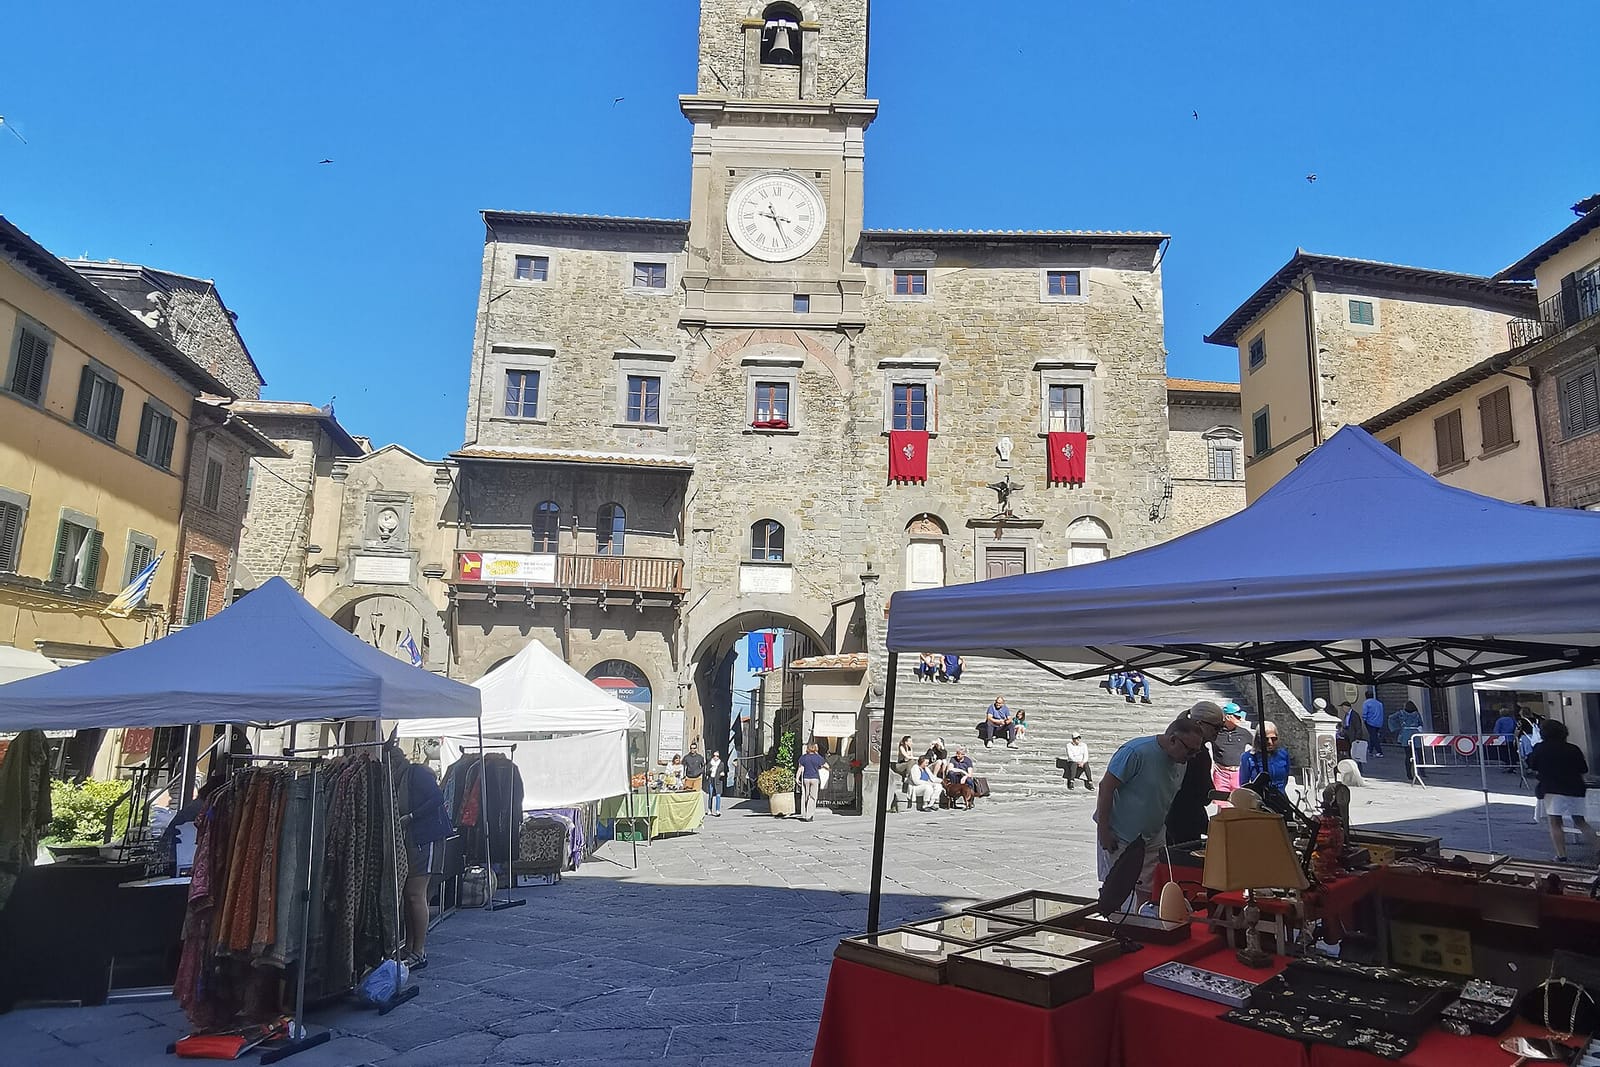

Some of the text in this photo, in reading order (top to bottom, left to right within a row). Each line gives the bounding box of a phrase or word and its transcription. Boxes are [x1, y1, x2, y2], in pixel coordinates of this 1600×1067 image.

[772, 187, 782, 197] XII
[788, 191, 794, 200] I
[795, 201, 806, 209] II
[745, 223, 758, 236] VIII
[755, 233, 766, 245] VII
